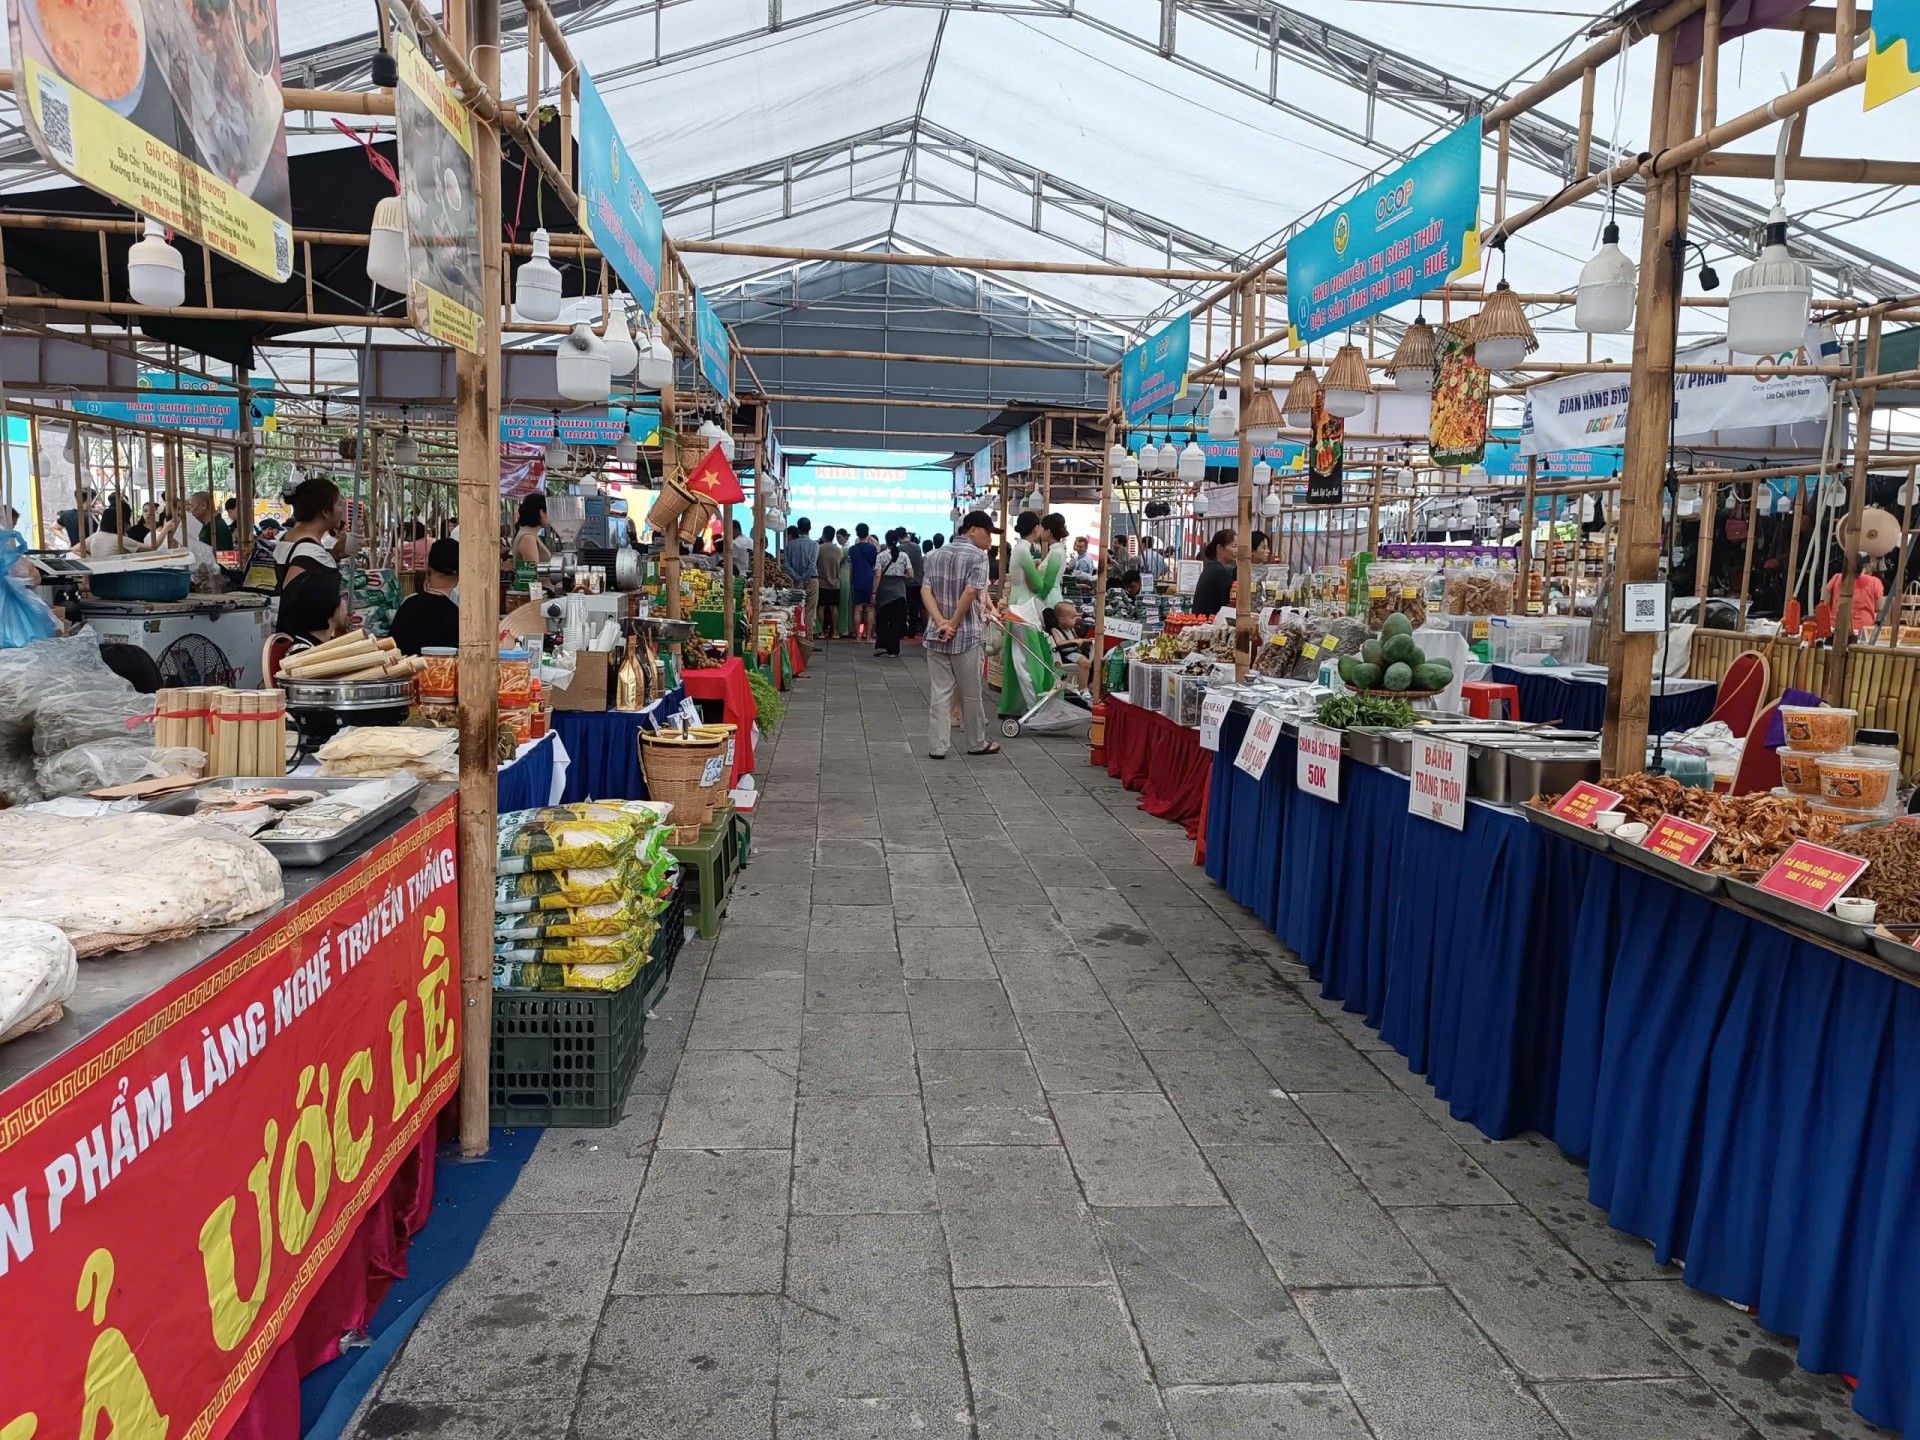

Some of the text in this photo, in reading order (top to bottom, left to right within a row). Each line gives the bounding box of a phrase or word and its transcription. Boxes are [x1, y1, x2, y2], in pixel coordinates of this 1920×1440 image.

[145, 140, 161, 161] Giò
[201, 174, 226, 204] Hương
[1376, 178, 1414, 221] OCOP
[1313, 281, 1329, 303] HKD
[1330, 258, 1366, 295] NGUYỄN
[1368, 251, 1384, 275] THỊ
[1386, 240, 1411, 266] BÍCH
[1414, 217, 1443, 252] THỦY
[1328, 297, 1345, 322] SẢN
[1348, 288, 1368, 313] TỈNH
[1424, 241, 1449, 279] HUẾ
[89, 404, 99, 412] 21
[504, 417, 527, 426] HTX
[1559, 396, 1581, 415] GIAN
[1583, 389, 1608, 411] HÀNG
[1308, 763, 1327, 788] 50K
[1425, 743, 1452, 772] BÁNH
[1415, 769, 1460, 807] TRÁNG TRỘN
[44, 1075, 172, 1232] PHẨM
[180, 1000, 266, 1114] LÀNG
[273, 929, 332, 1036] NGHỀ
[336, 890, 404, 975] TRUYỀN
[407, 847, 456, 922] THỐNG
[199, 1047, 374, 1351] ƯỚC
[388, 905, 455, 1122] LỄ
